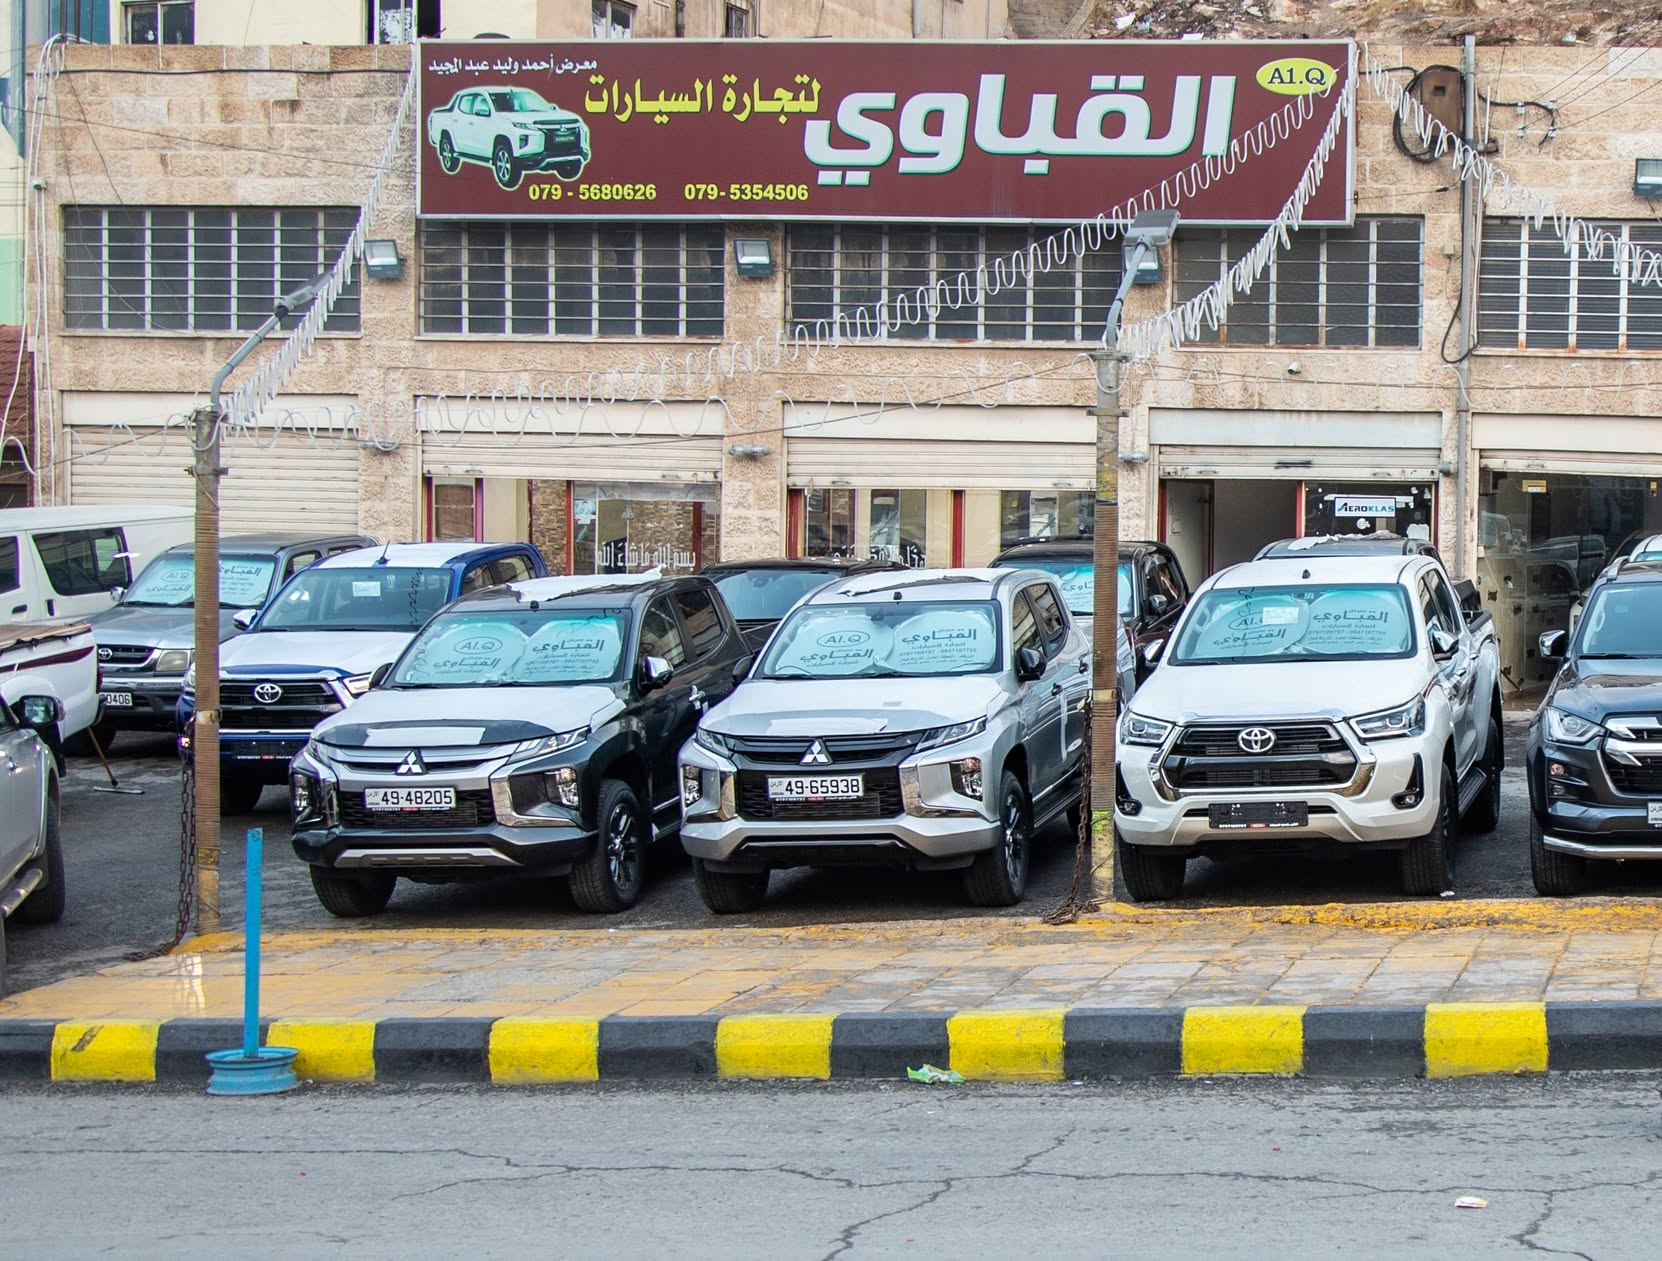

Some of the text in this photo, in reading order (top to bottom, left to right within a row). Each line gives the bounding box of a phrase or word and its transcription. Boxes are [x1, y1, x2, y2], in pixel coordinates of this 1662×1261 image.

[428, 53, 597, 76] معرض أحمد وليد عبد المجيد
[1267, 67, 1327, 86] A1.Q
[584, 73, 821, 124] لتجارة السيارات
[803, 73, 1237, 187] القباوي
[528, 183, 562, 201] 079
[578, 183, 657, 201] 5680626
[729, 183, 809, 201] 5354506
[1337, 502, 1395, 513] AEROKLAS
[1313, 610, 1389, 623] القباوي
[902, 629, 977, 645] القباوي
[1213, 629, 1287, 645] القباوي
[532, 639, 605, 654] القباوي
[433, 657, 502, 669] القباوي
[800, 649, 874, 663] القباوي
[785, 779, 860, 795] 49-65938
[381, 790, 453, 805] 49-48205
